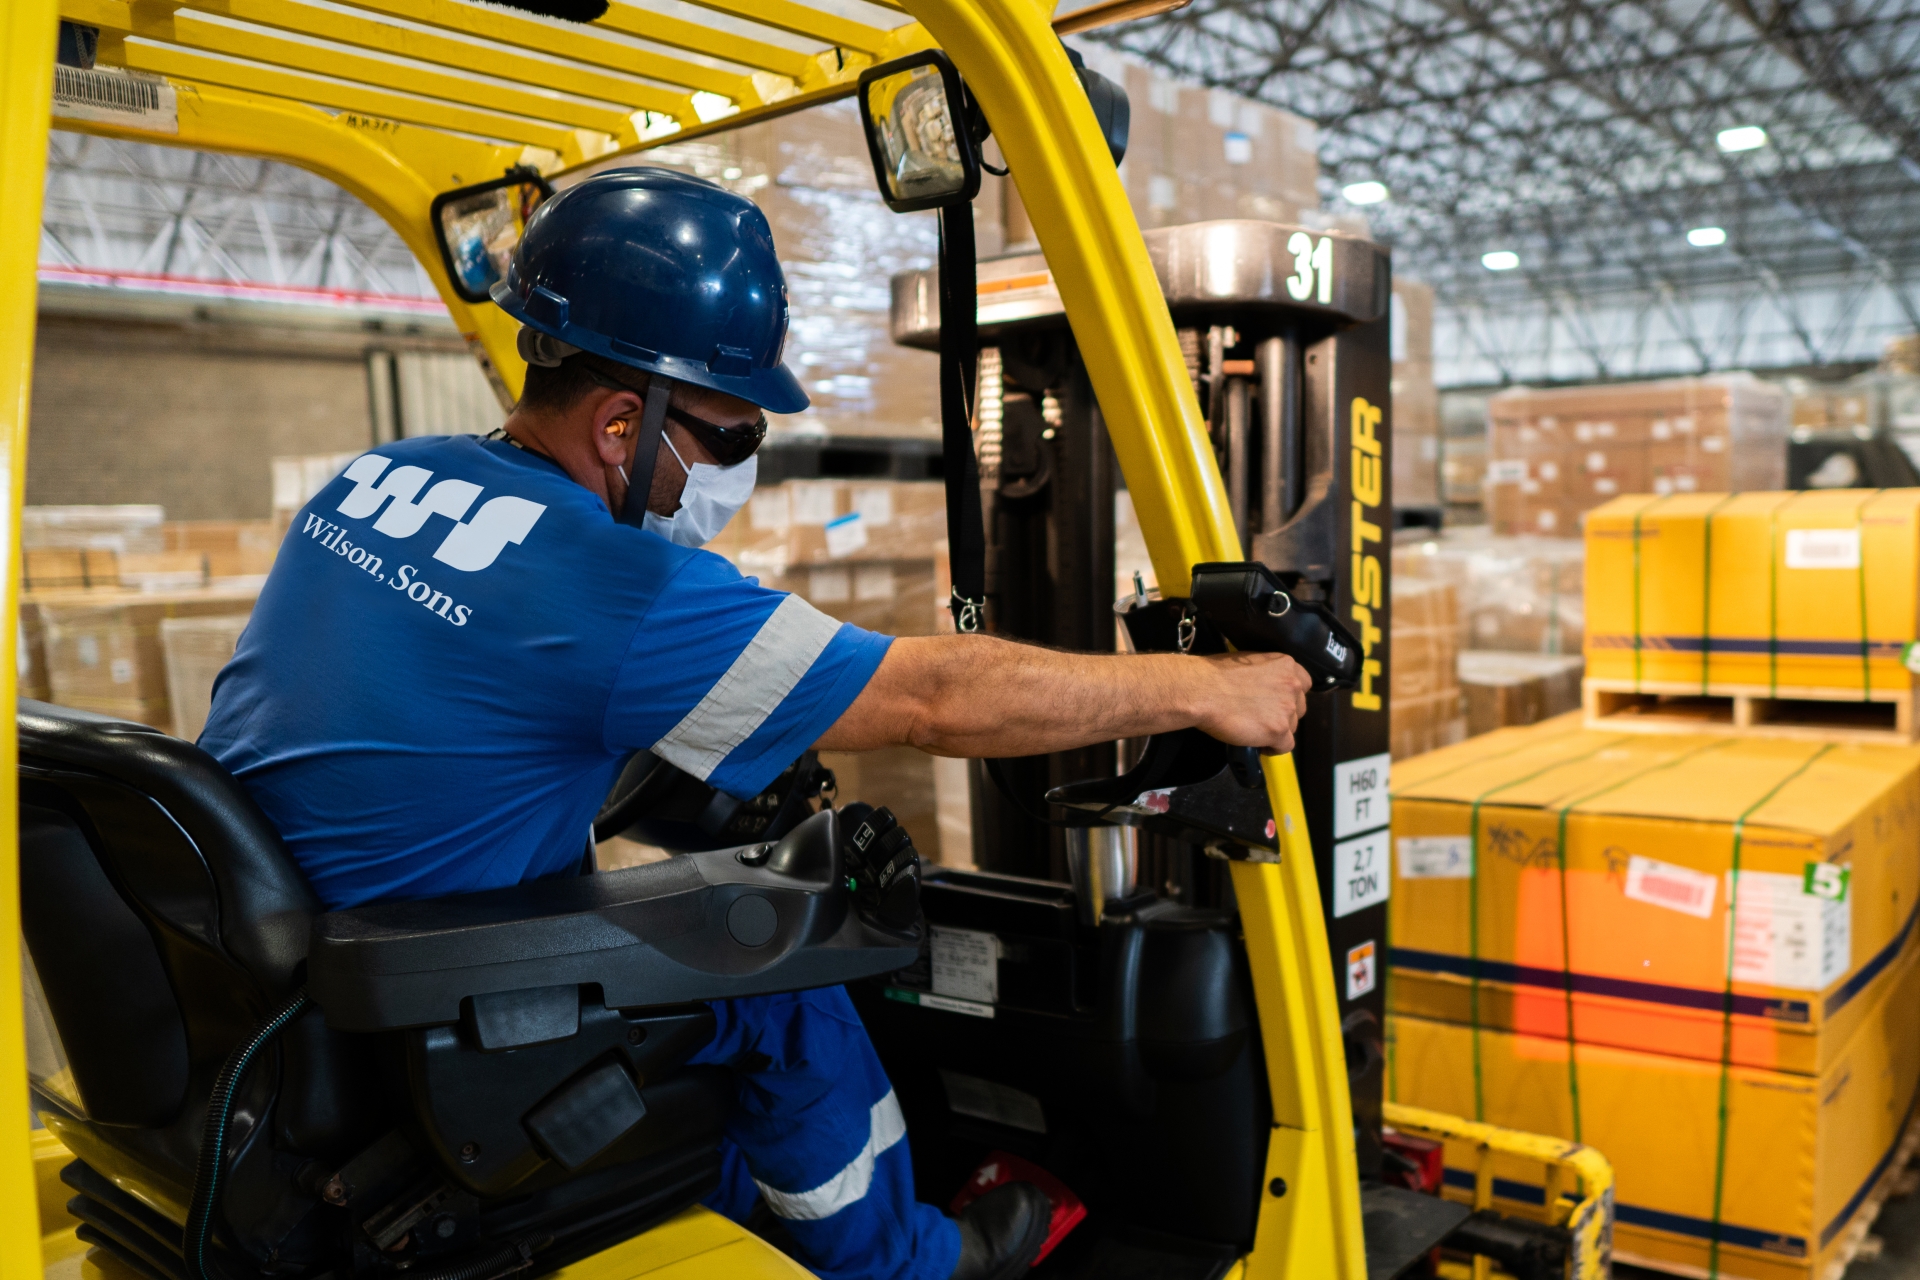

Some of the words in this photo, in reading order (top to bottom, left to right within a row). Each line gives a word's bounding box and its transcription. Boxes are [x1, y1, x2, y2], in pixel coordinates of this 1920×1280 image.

[1286, 231, 1333, 305] 31
[302, 512, 385, 583] Wilson,
[387, 564, 474, 627] Sons
[1351, 396, 1382, 712] HYSTER
[1349, 768, 1377, 795] H60
[1355, 797, 1371, 822] FT
[1353, 846, 1373, 873] 2,7
[1348, 872, 1378, 901] TON
[1812, 862, 1842, 898] 5
